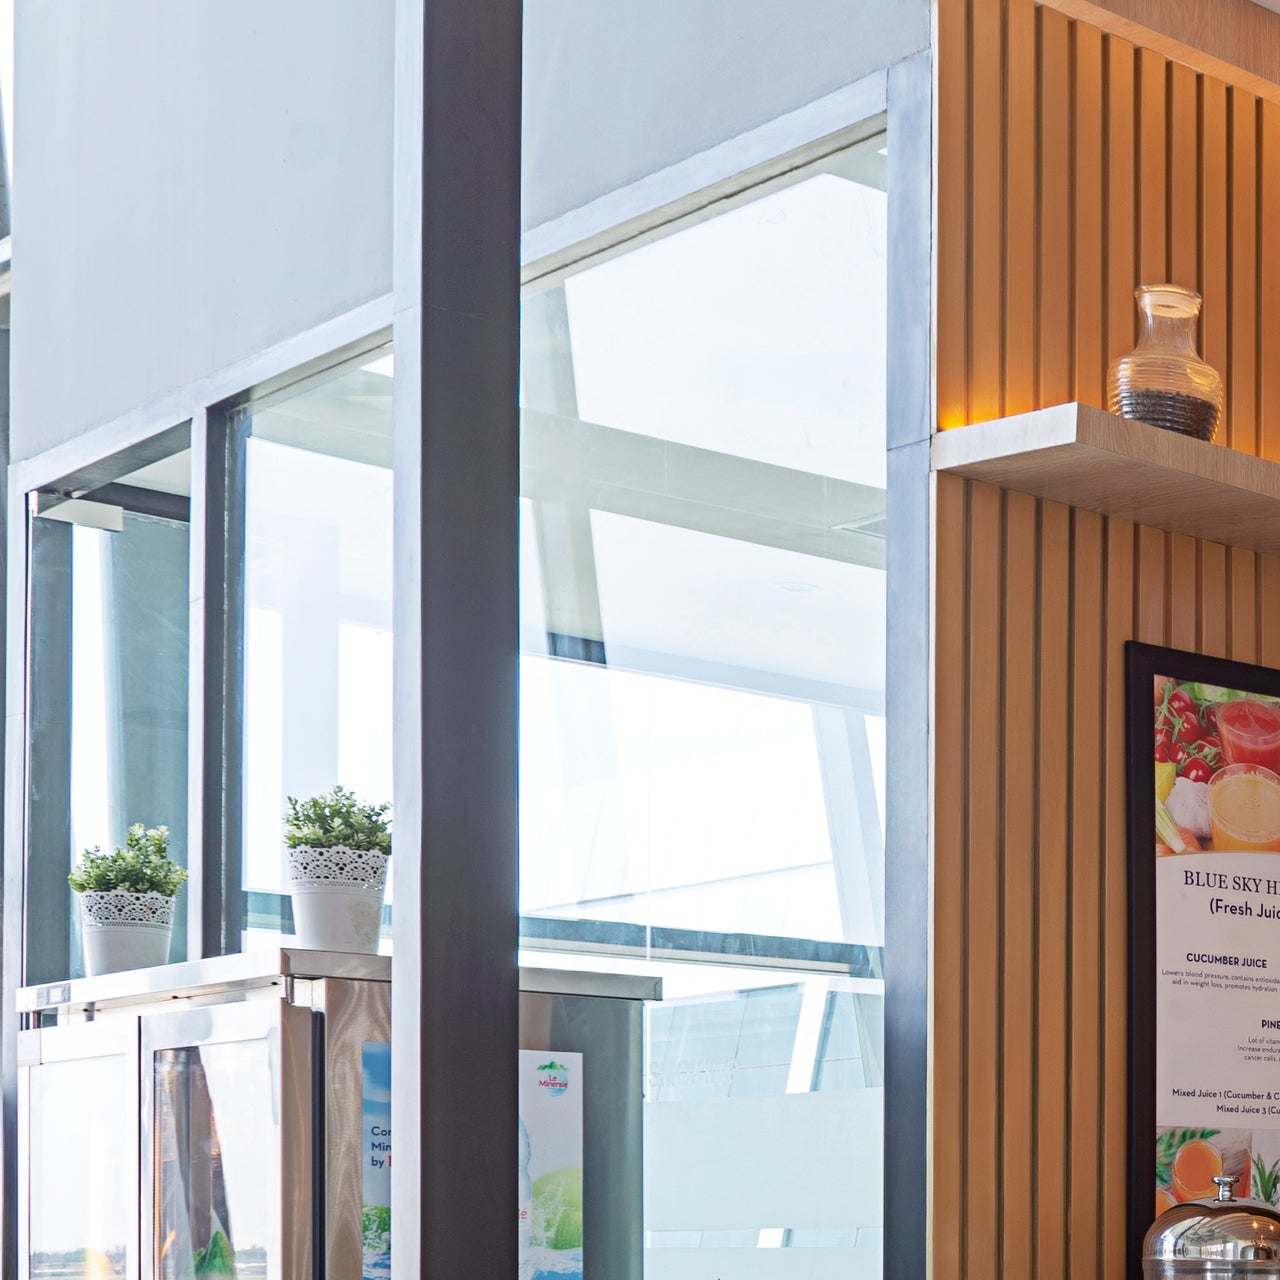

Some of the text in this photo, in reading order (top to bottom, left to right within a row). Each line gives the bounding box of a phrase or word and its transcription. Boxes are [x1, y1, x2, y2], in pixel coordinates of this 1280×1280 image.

[1184, 870, 1228, 889] BLUE
[1232, 875, 1261, 893] SKY
[1209, 897, 1252, 917] (Fresh
[1186, 952, 1266, 968] CUCUMBER JUICE
[1172, 1088, 1196, 1096] Mixed
[1197, 1089, 1217, 1097] Juice
[1223, 1090, 1264, 1099] (Cucumber
[371, 1156, 384, 1168] by
